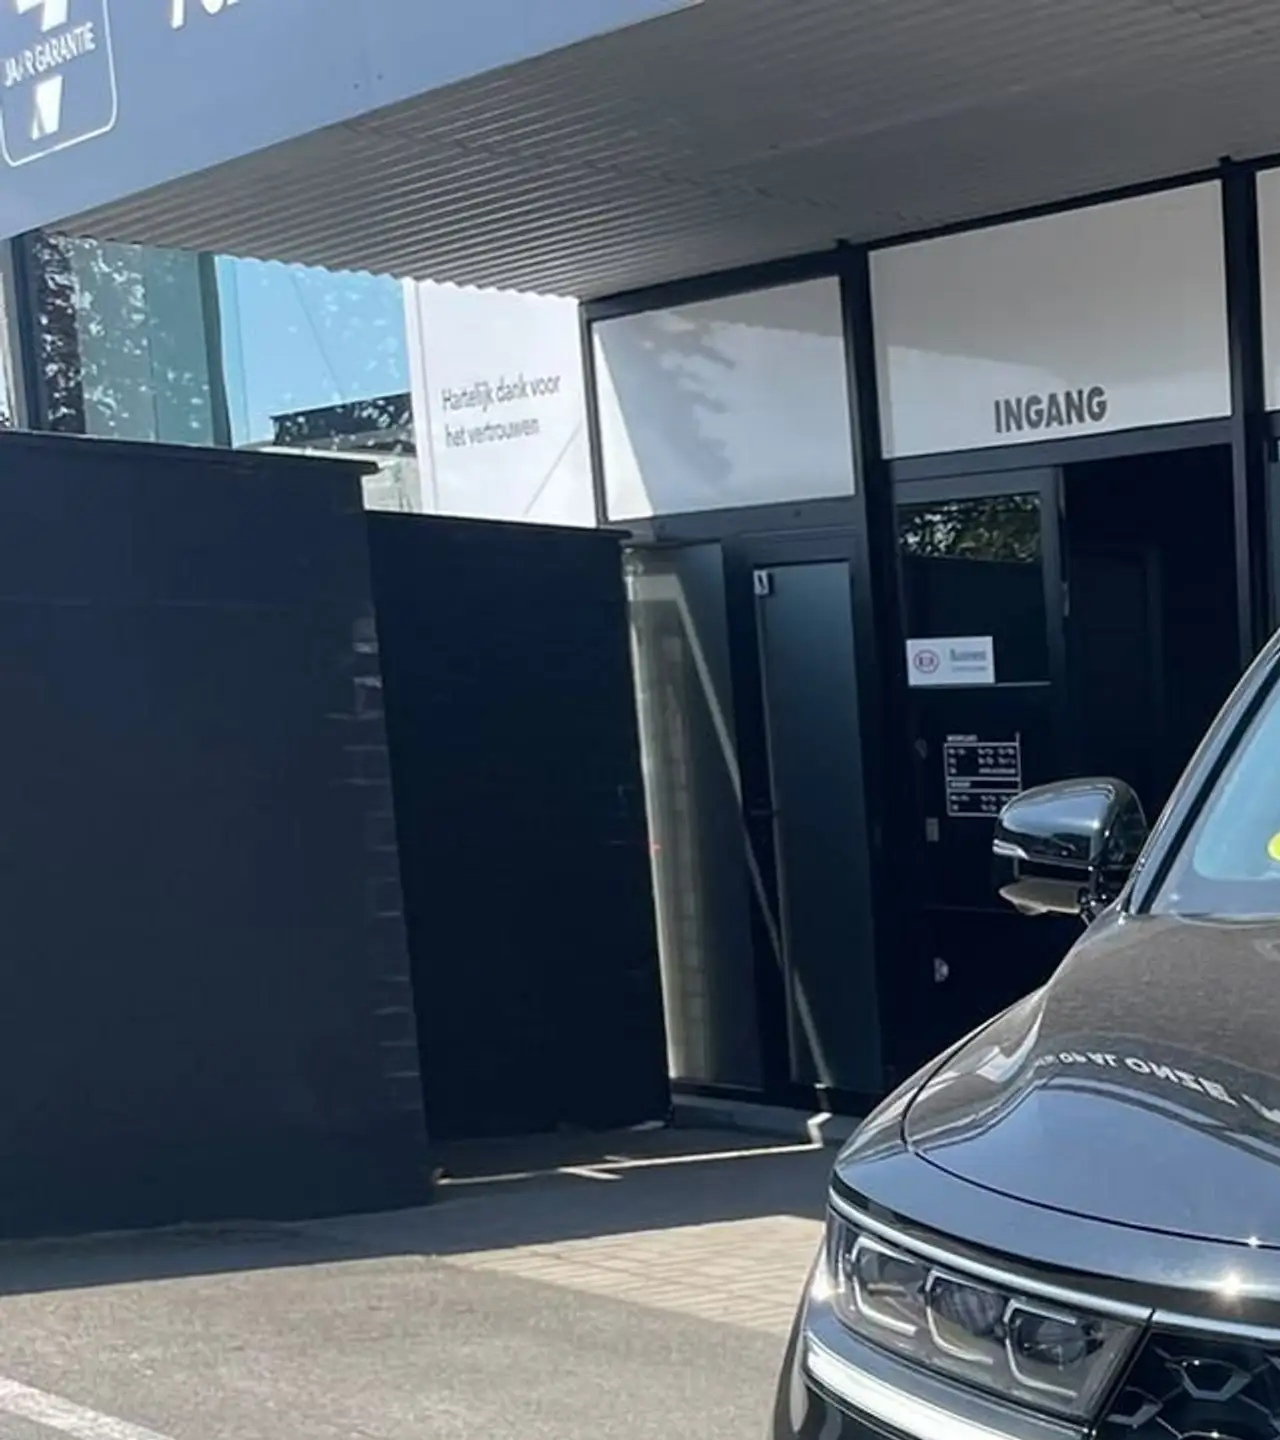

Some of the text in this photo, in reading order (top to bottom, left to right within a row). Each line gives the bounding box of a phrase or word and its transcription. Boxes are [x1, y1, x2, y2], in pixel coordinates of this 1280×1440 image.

[35, 21, 96, 72] GARANTIE
[496, 372, 530, 402] dank
[531, 375, 560, 397] voor
[994, 386, 1107, 433] INGANG
[445, 424, 467, 448] het
